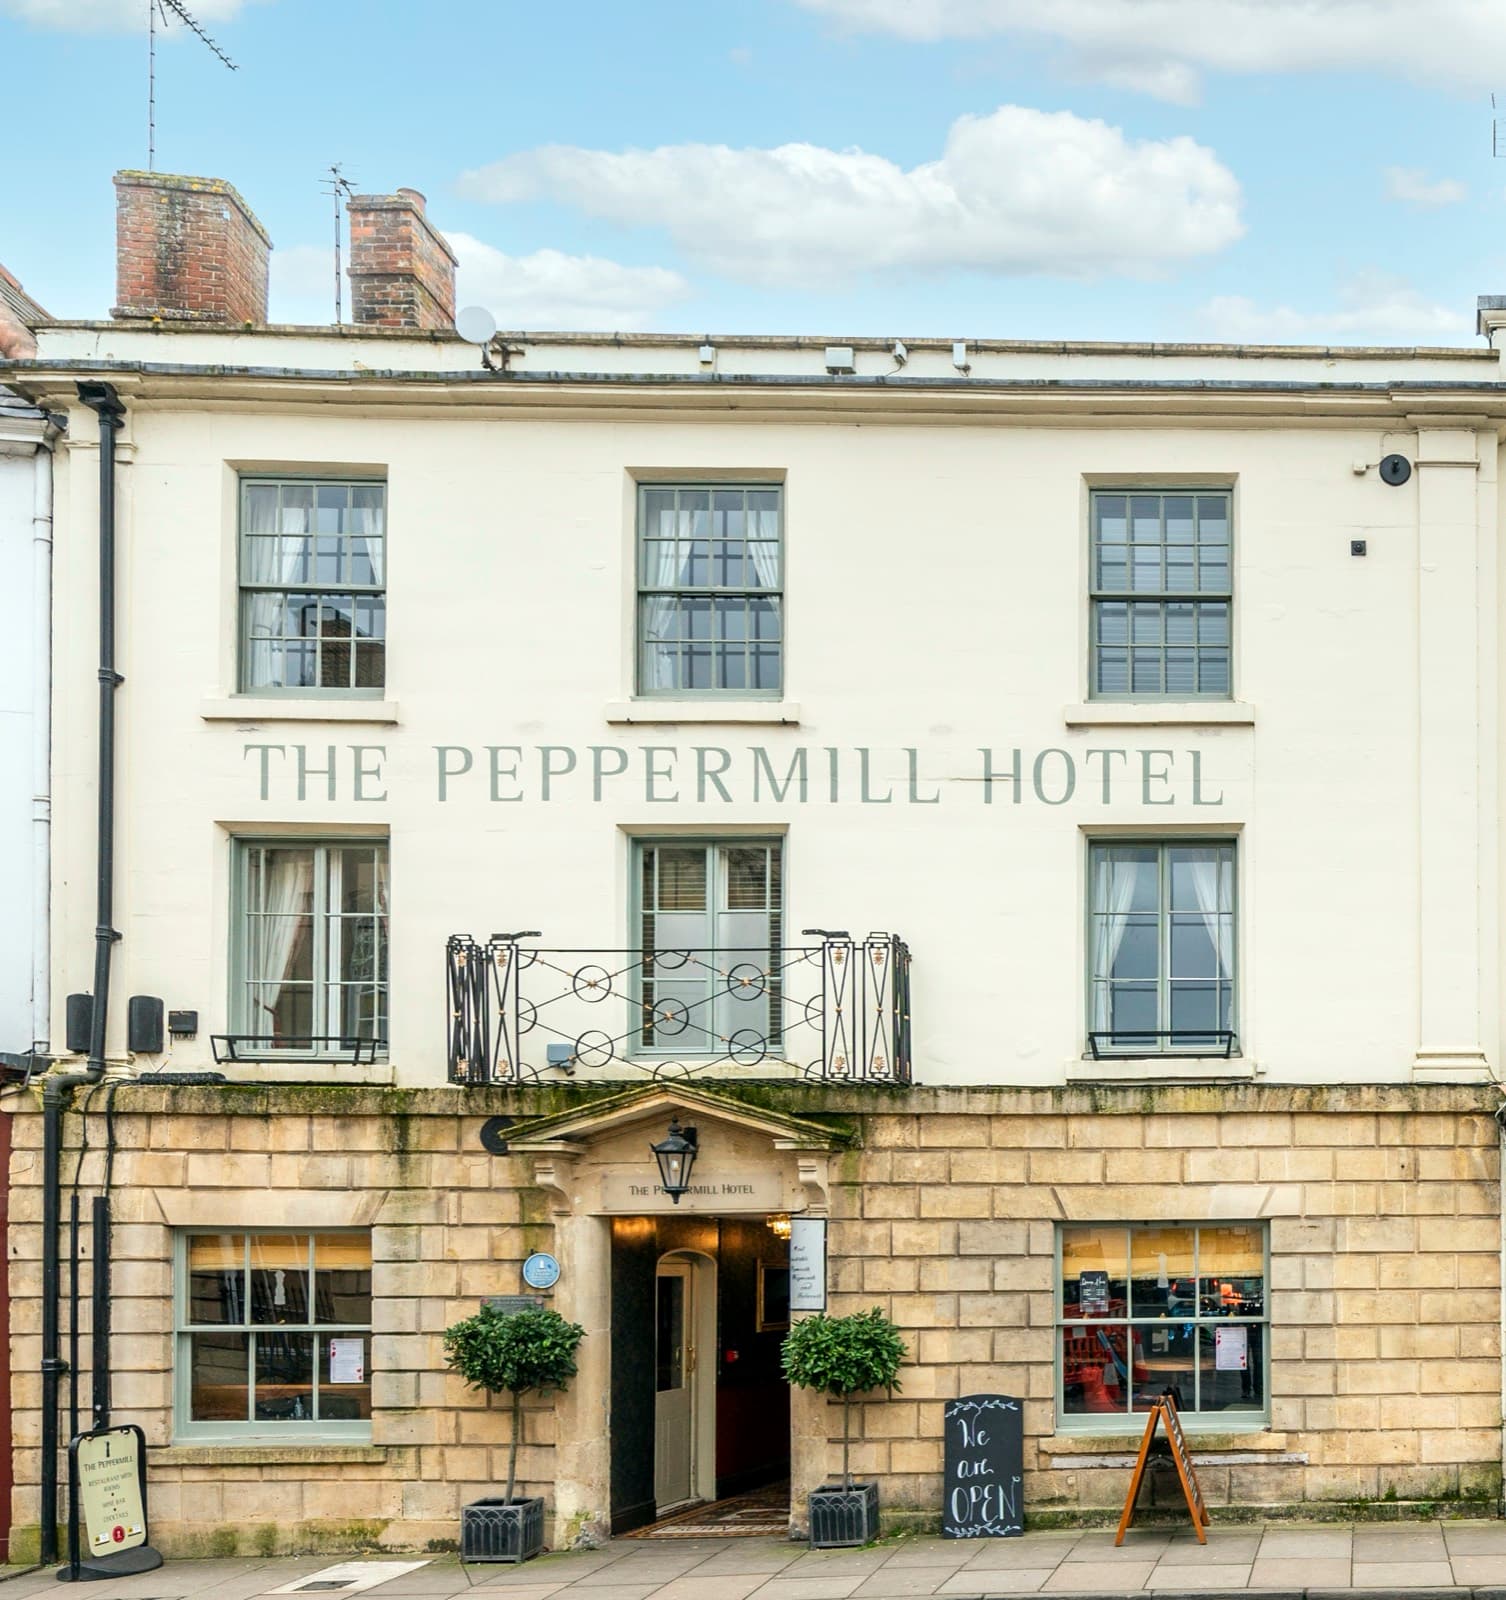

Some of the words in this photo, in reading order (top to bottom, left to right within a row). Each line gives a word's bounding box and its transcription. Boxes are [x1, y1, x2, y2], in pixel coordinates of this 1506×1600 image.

[243, 744, 388, 801] THE
[431, 745, 940, 803] PEPPERMILL
[977, 747, 1223, 805] HOTEL
[629, 1185, 649, 1196] THE
[722, 1183, 755, 1194] HOTEL
[957, 1409, 990, 1448] We
[84, 1463, 96, 1472] THE
[98, 1456, 133, 1468] PEPPERMILL
[957, 1458, 994, 1479] are
[951, 1475, 1021, 1524] OPEN
